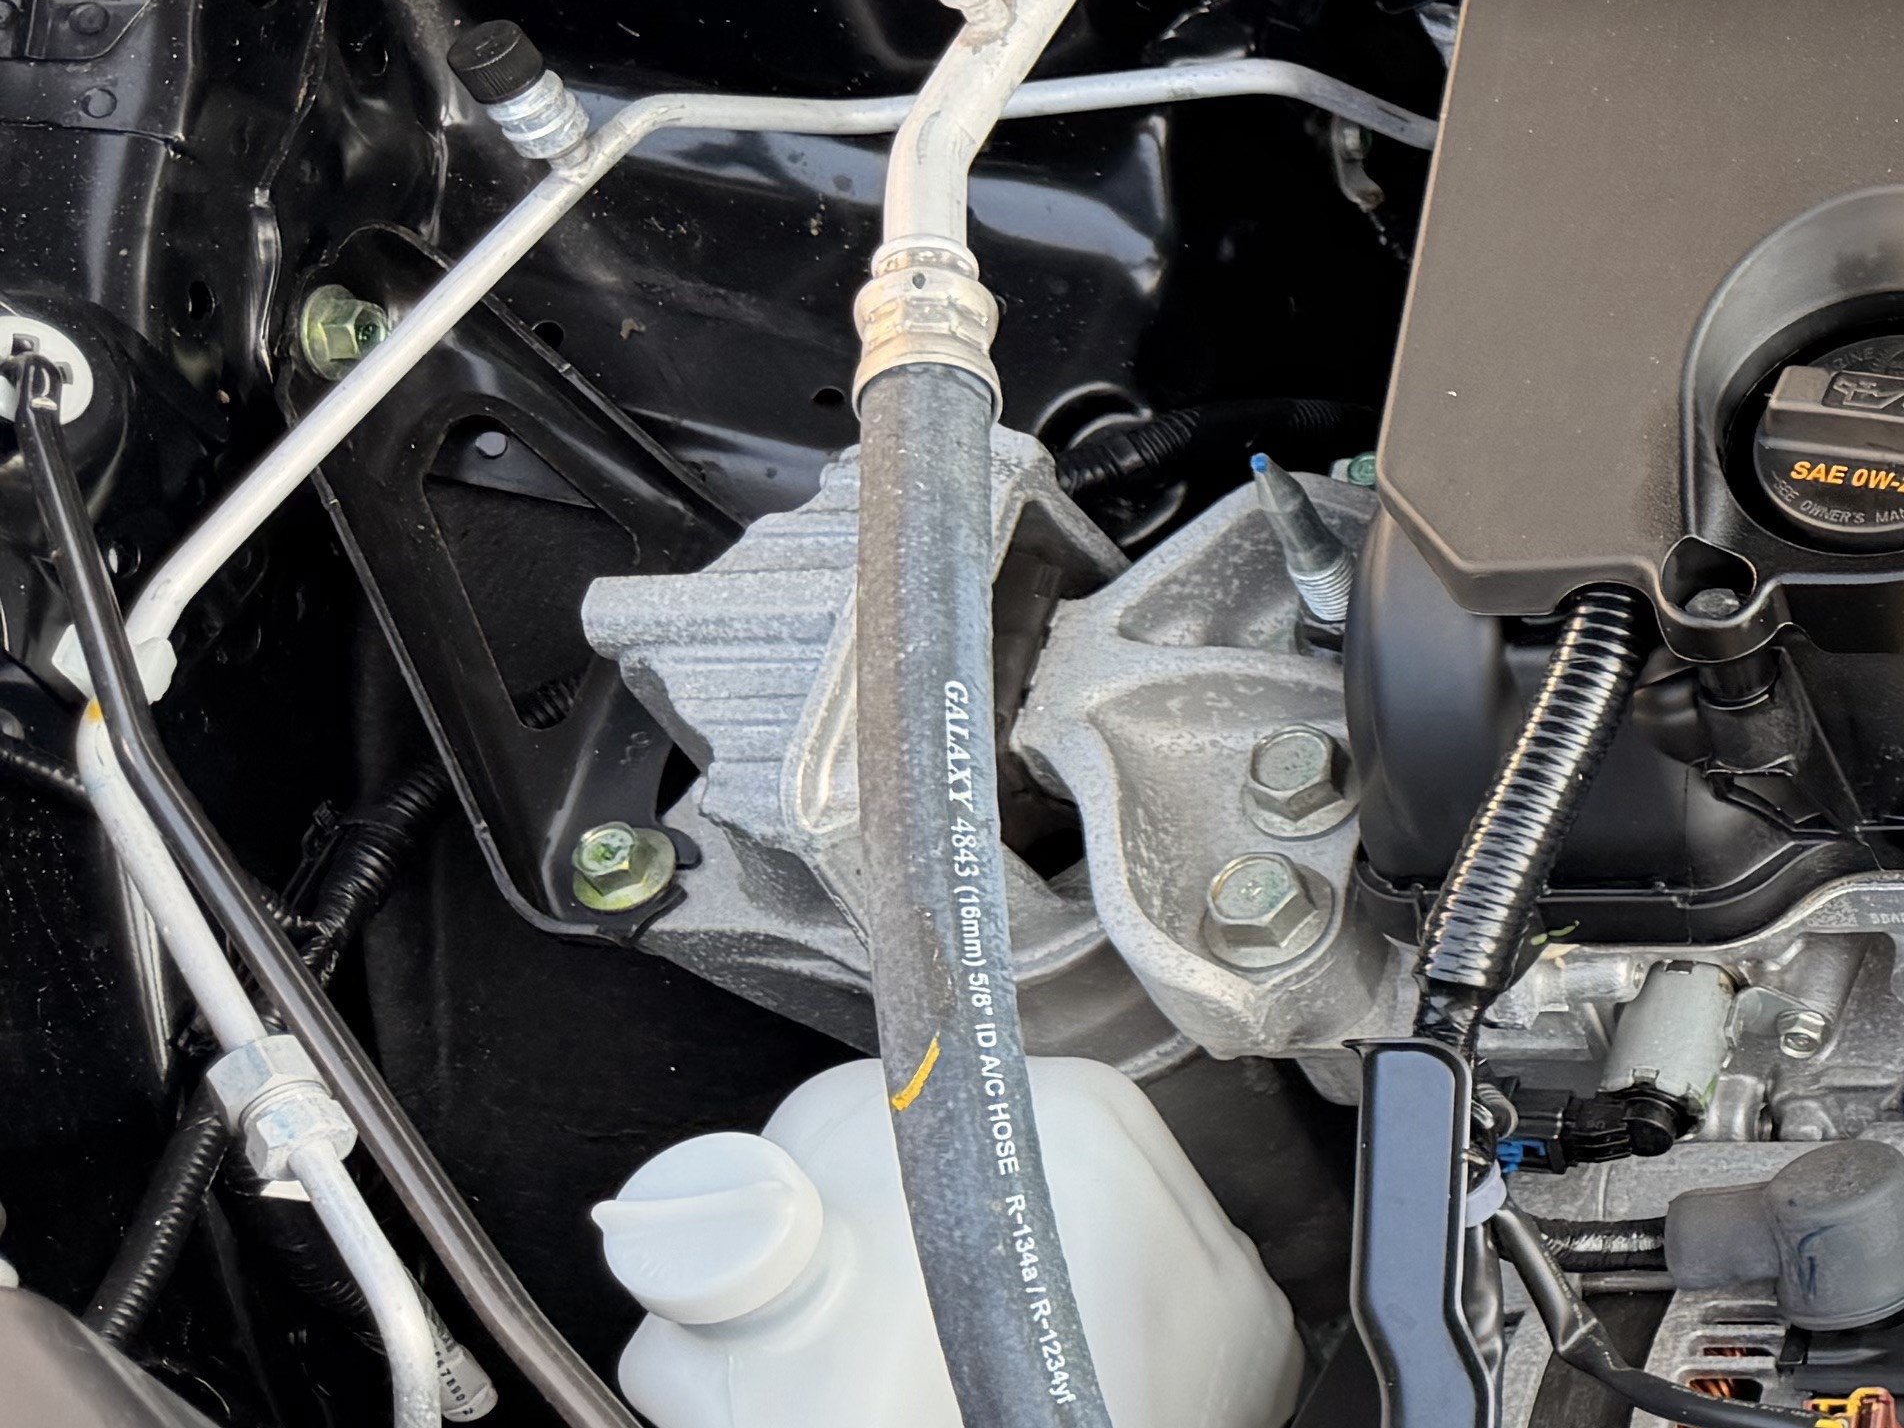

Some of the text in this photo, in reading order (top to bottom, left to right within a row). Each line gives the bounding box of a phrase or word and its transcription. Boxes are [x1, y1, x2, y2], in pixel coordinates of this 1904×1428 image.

[1790, 460, 1849, 486] SAE
[1800, 499, 1866, 525] OWNER'S
[945, 680, 976, 812] GALAXY
[948, 815, 979, 879] 4843
[954, 883, 986, 968] (16mm)
[967, 971, 995, 1017] 5/8"
[972, 1021, 998, 1051] ID
[979, 1052, 1007, 1099] A/C
[989, 1101, 1021, 1176] HOSE
[1005, 1193, 1041, 1283] R-134a
[1029, 1297, 1078, 1405] R-1234yf
